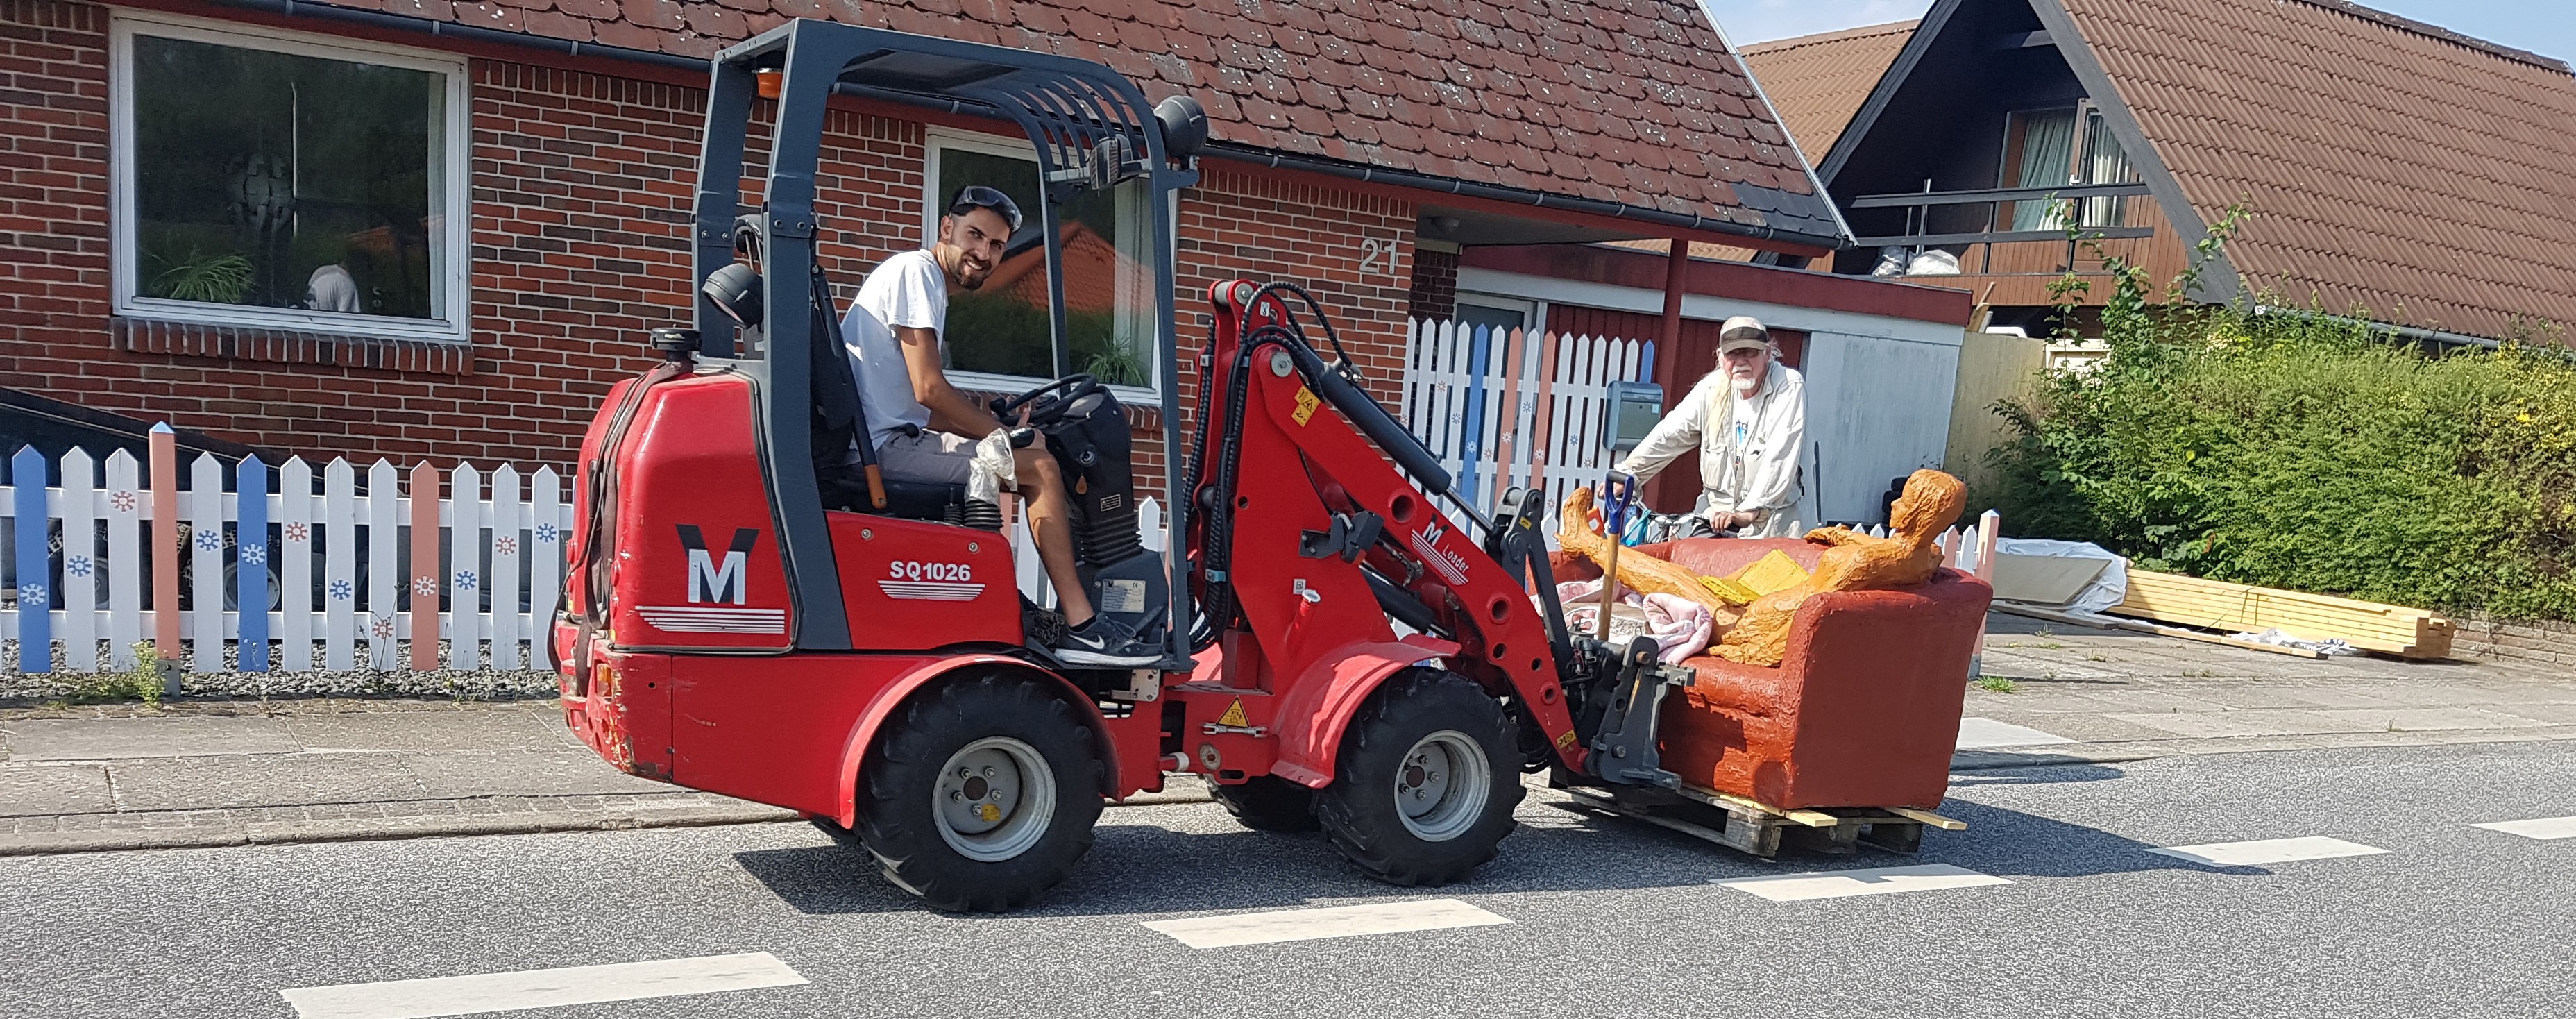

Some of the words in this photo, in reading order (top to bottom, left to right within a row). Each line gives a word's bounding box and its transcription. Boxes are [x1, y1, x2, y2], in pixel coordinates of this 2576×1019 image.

[1359, 239, 1396, 275] 21
[1422, 521, 1443, 546] M
[1442, 544, 1469, 573] Loader
[890, 560, 971, 582] SQ1026
